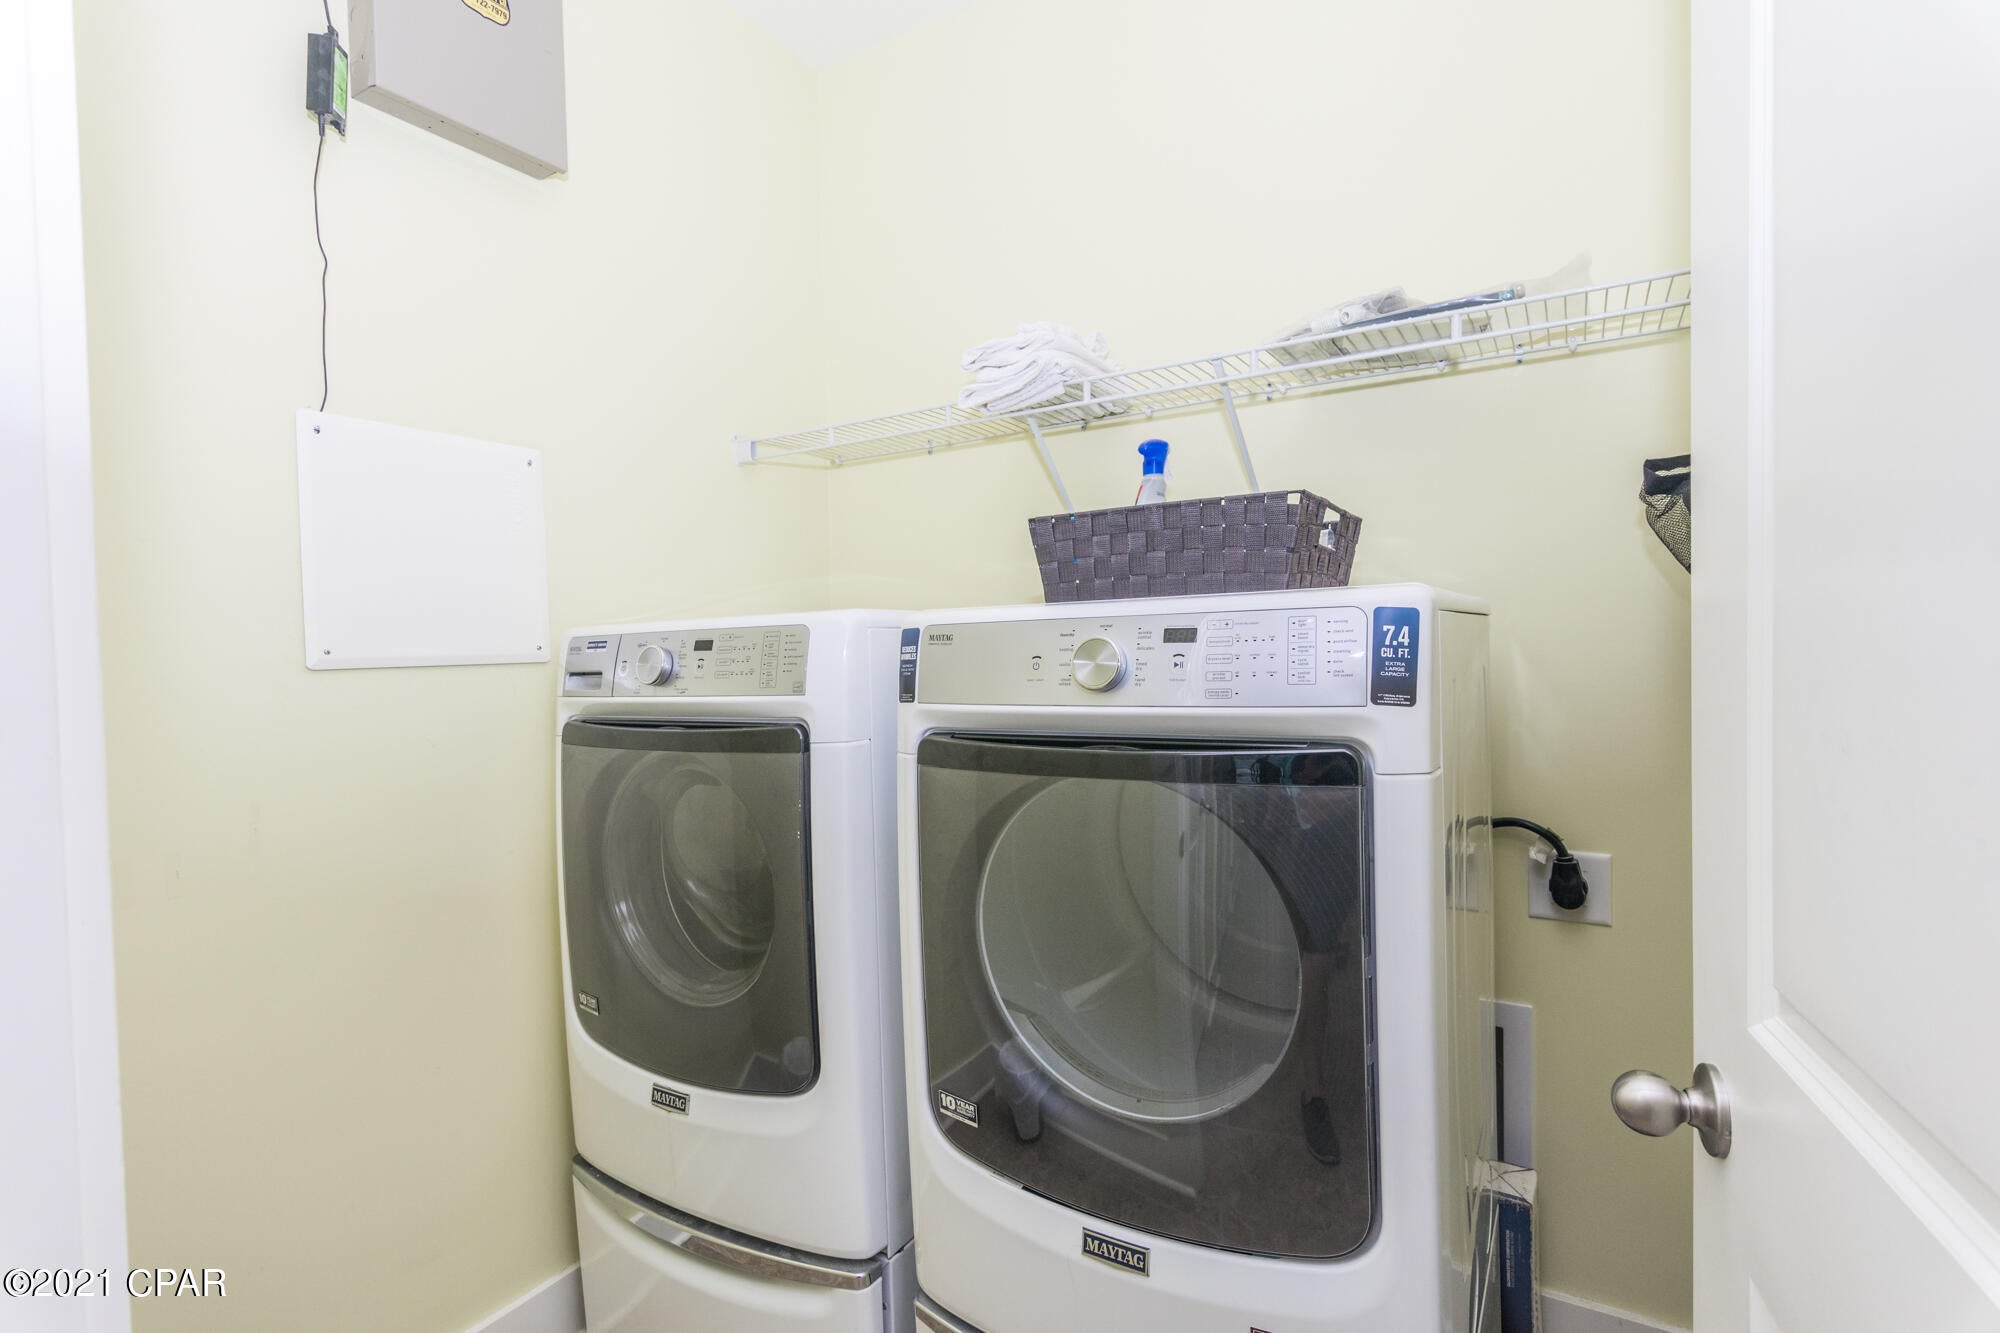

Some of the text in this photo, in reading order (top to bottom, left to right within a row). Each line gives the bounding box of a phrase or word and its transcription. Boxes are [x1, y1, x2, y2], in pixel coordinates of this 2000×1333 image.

[928, 633, 954, 642] MAYTAG
[1382, 625, 1410, 646] 7.4
[1381, 648, 1411, 659] CU. FT.
[653, 1090, 686, 1109] MAYTAG
[941, 1093, 975, 1112] 10 YEAR
[1085, 1236, 1145, 1269] MAYTAG
